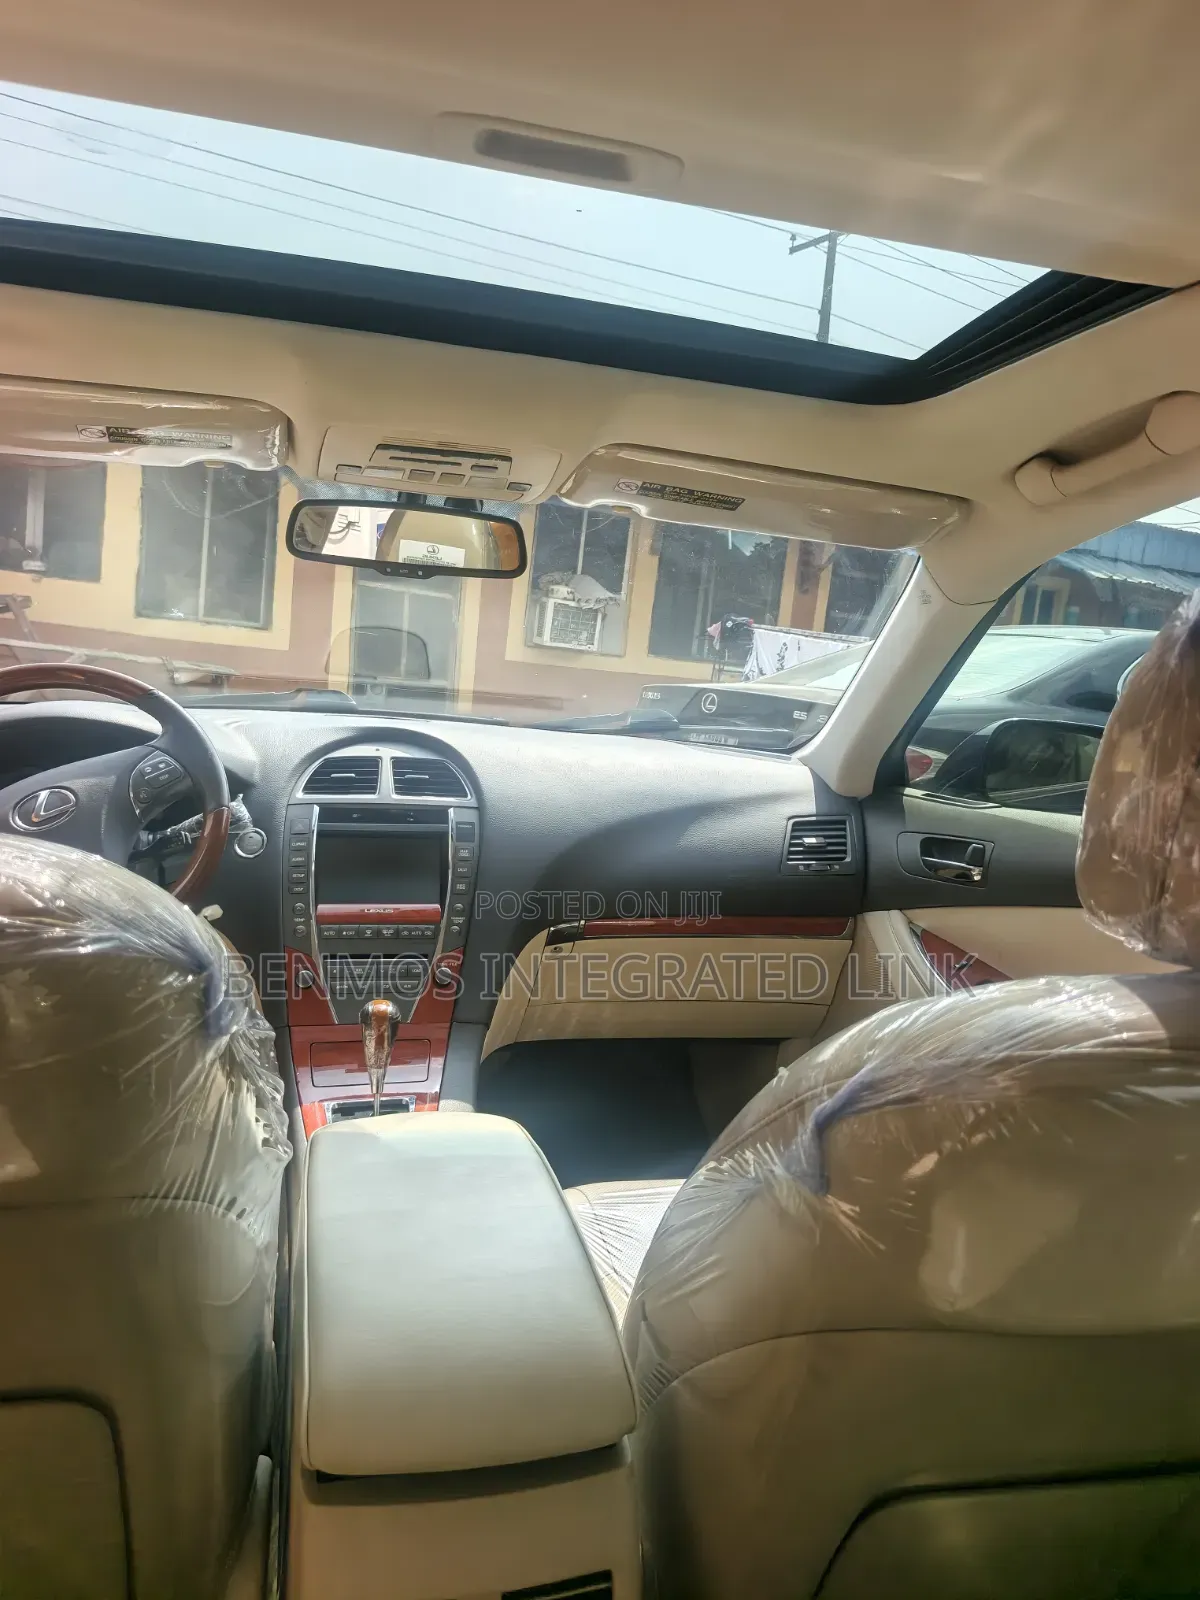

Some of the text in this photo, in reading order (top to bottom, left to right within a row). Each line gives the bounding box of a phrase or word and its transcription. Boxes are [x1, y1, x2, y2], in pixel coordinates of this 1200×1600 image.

[171, 431, 231, 441] WARNING
[643, 482, 743, 503] AIR BAG WARNING
[793, 710, 808, 720] ES
